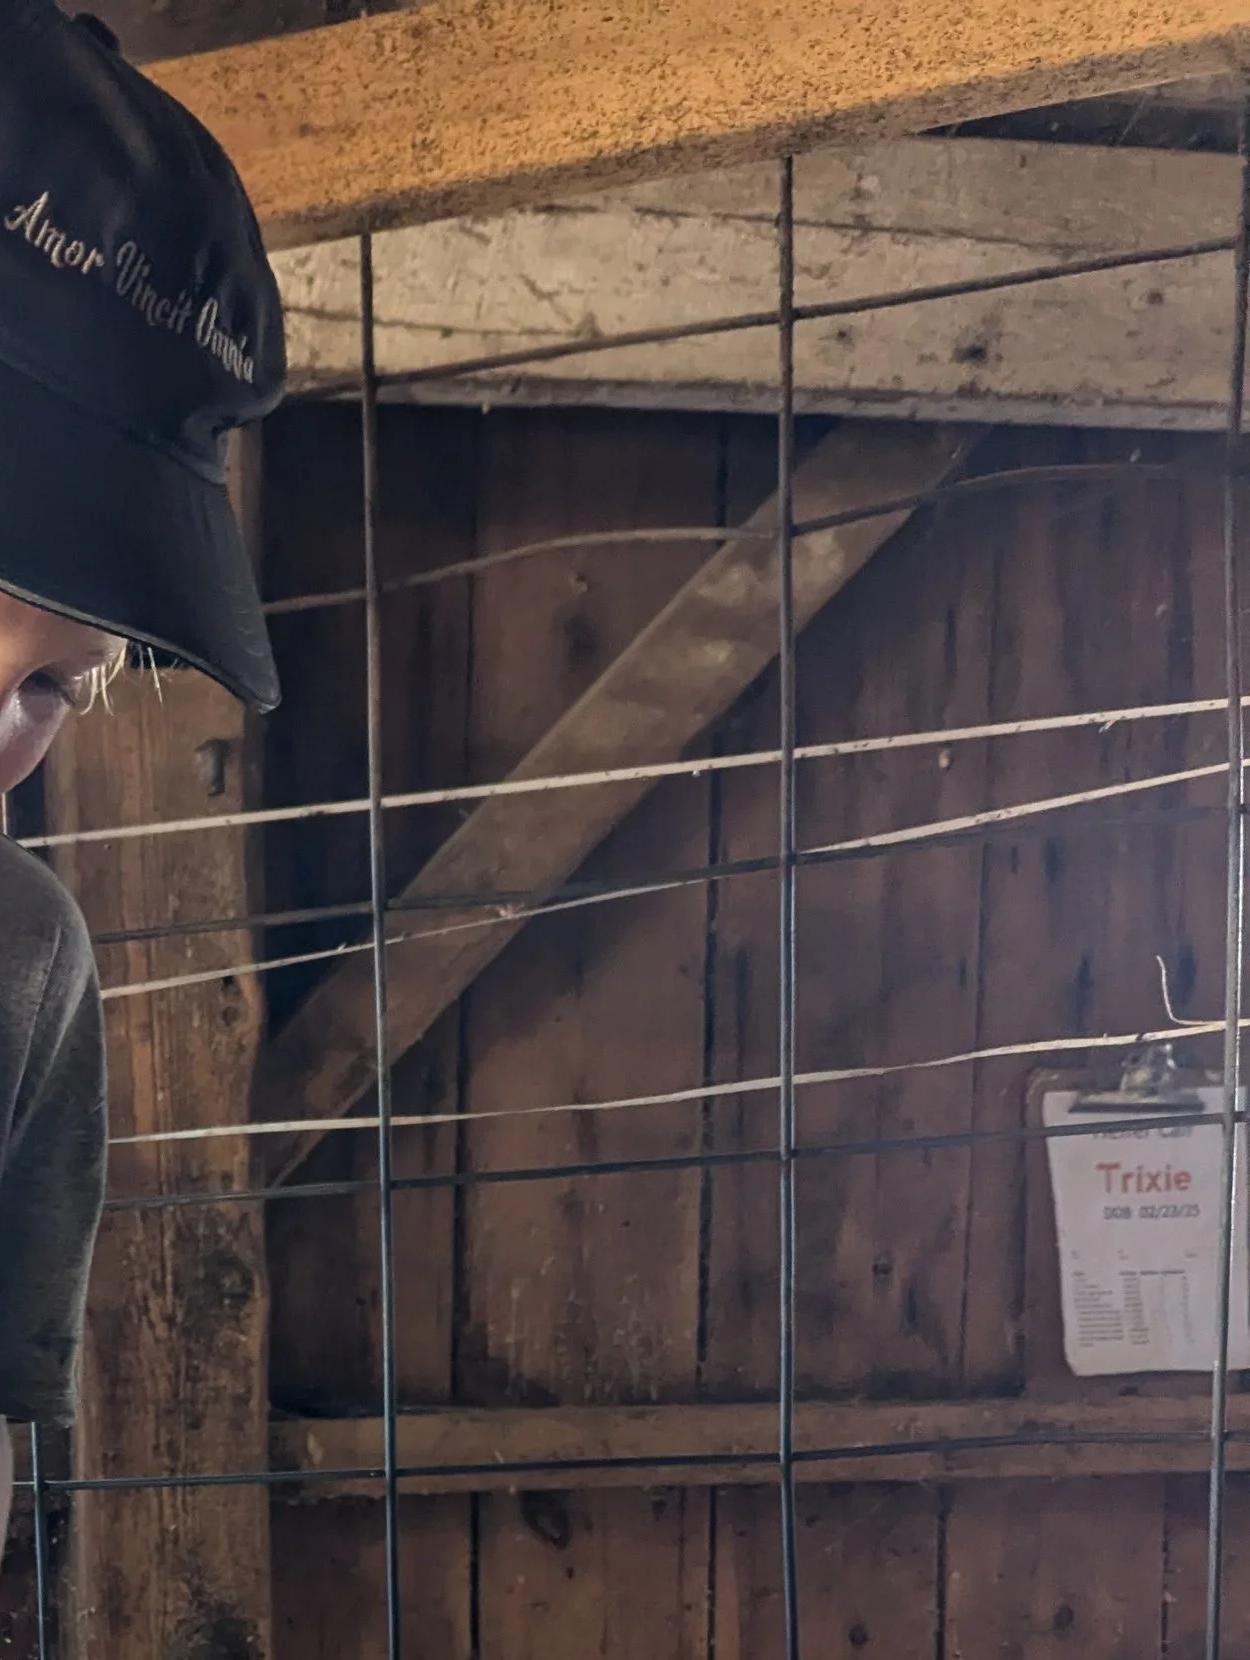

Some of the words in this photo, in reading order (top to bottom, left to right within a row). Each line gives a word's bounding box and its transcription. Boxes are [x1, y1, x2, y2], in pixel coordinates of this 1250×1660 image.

[3, 190, 105, 275] Amor
[115, 239, 193, 335] Vincit
[1094, 1162, 1193, 1194] Trixie
